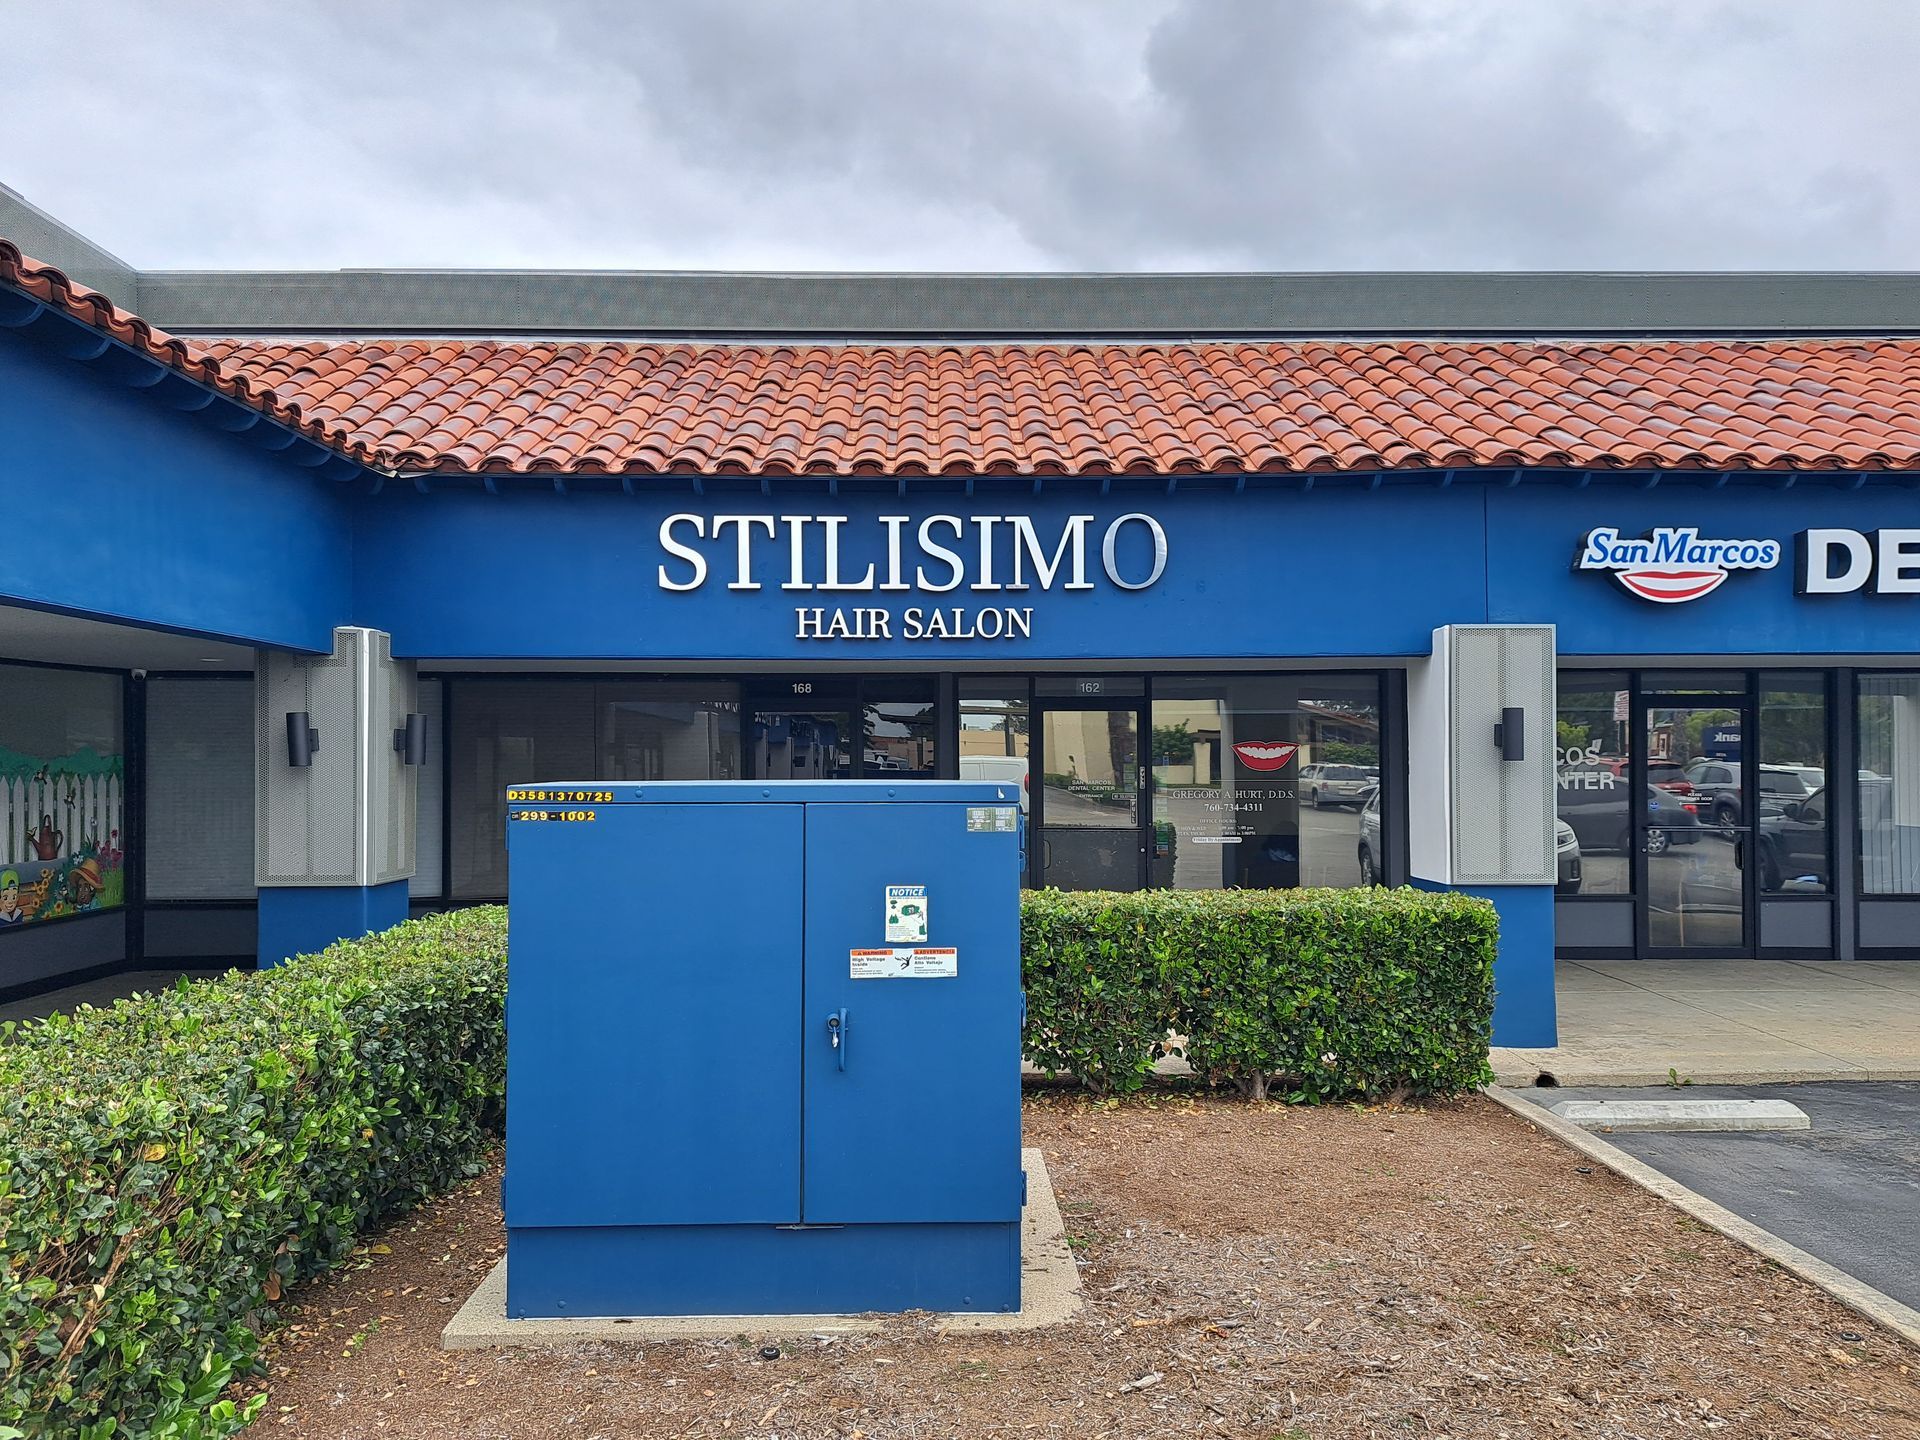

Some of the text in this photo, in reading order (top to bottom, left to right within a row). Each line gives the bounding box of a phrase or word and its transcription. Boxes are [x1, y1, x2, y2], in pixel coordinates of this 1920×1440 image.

[658, 513, 1169, 592] STILISIMO
[1587, 532, 1775, 564] San Marcos
[1806, 528, 1920, 595] DE
[794, 607, 1034, 640] HAIR SALON
[792, 683, 812, 694] 168
[1079, 682, 1101, 694] 162
[508, 790, 613, 801] D3581370725
[1172, 789, 1296, 800] GREGORY A. HURT, D.D.S.
[1204, 803, 1264, 812] 760-734-4311
[520, 811, 595, 821] 299-1002
[891, 888, 924, 896] NOTICE
